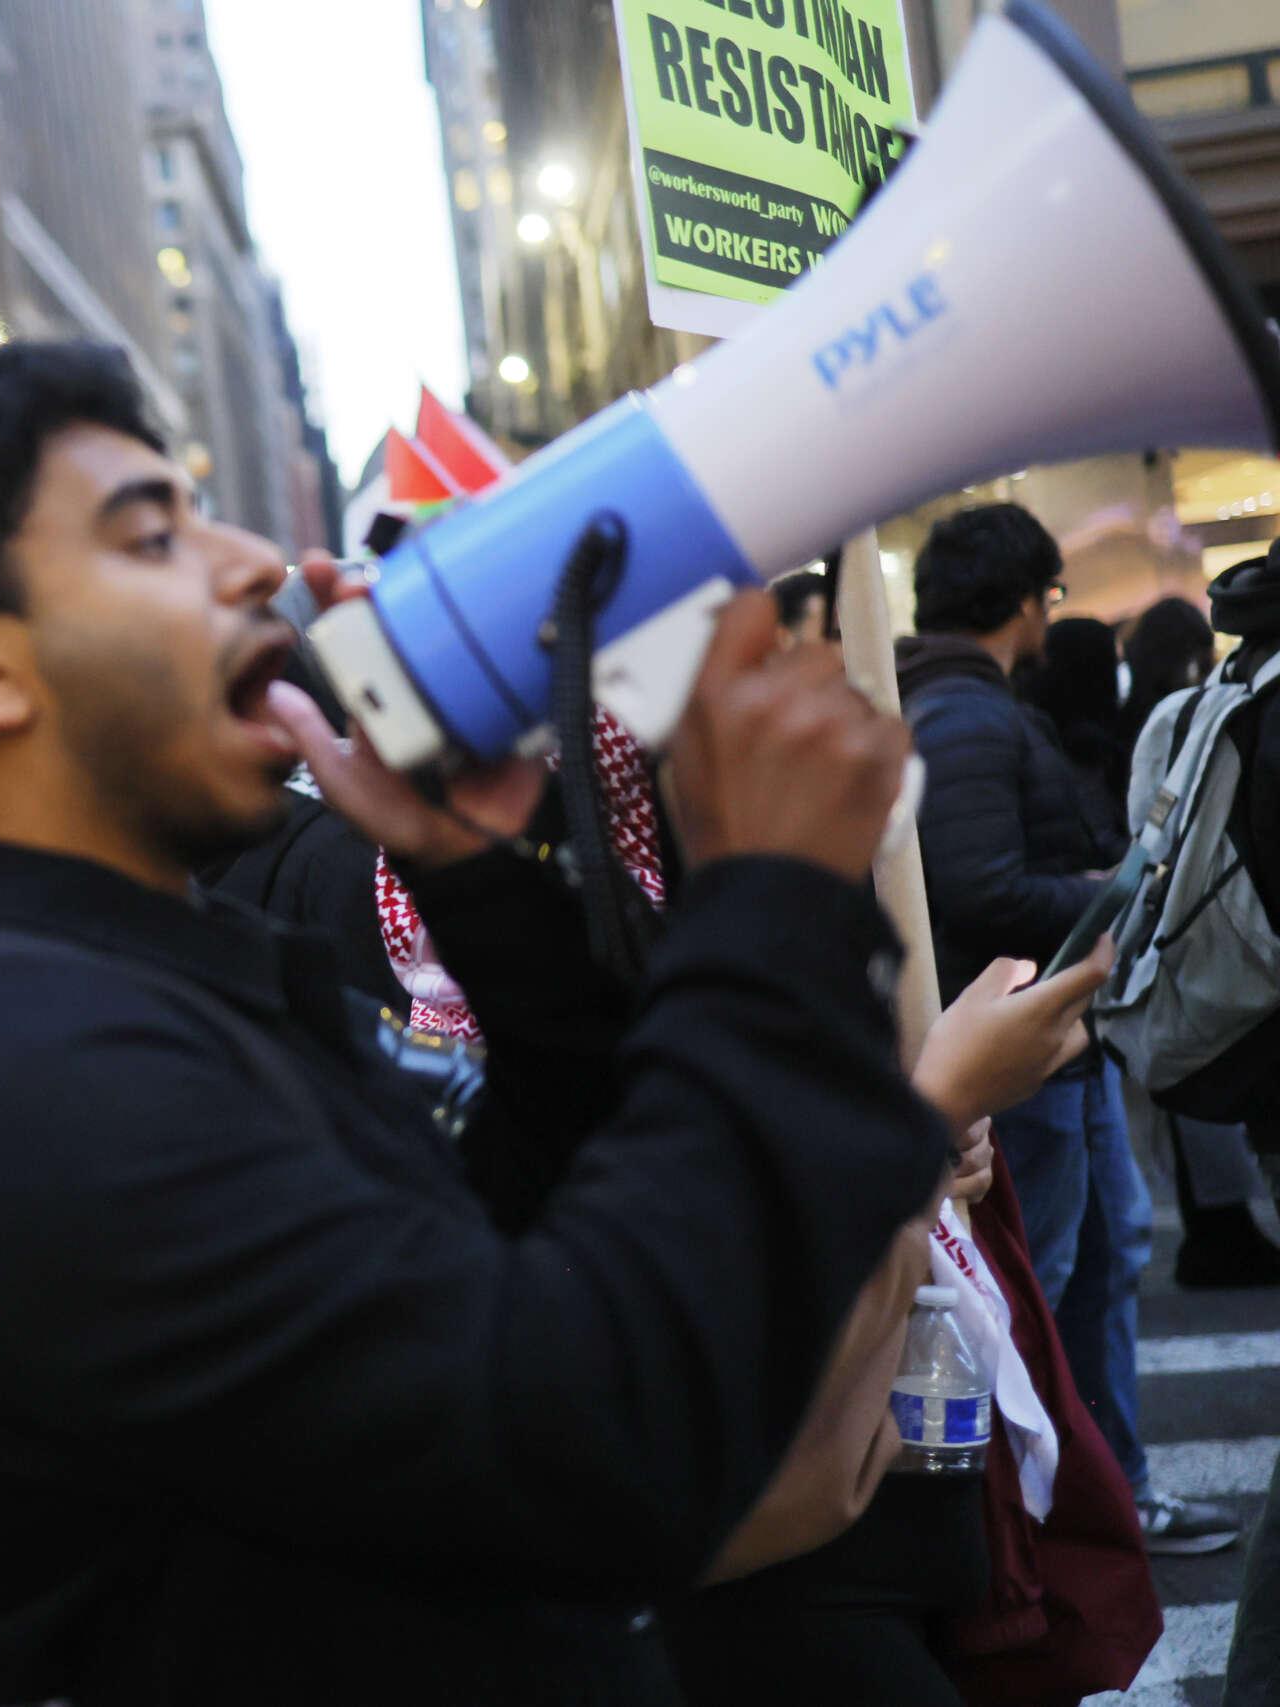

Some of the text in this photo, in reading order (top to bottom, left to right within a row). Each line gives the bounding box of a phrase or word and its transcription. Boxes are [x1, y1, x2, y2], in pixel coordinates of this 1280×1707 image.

[647, 13, 899, 186] RESISTANCE
[648, 164, 805, 228] @workersworld_party
[664, 213, 803, 276] WORKERS
